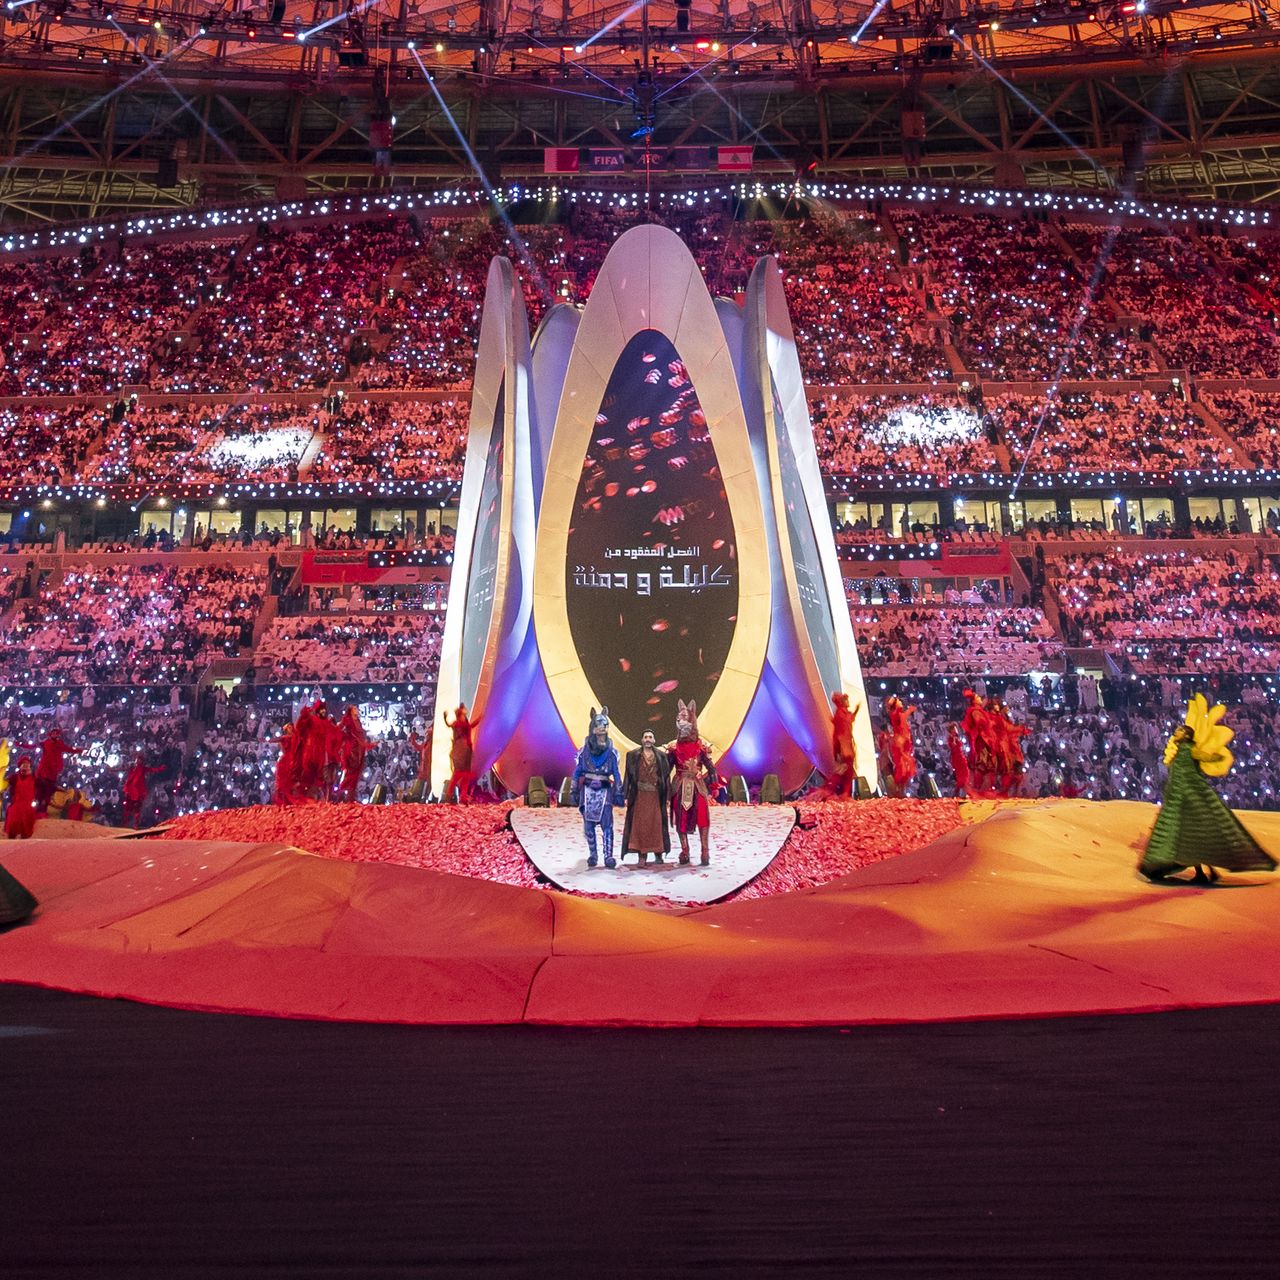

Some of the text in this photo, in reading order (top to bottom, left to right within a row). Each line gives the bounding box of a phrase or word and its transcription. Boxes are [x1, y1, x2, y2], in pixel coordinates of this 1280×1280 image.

[594, 155, 619, 165] FIFA
[604, 546, 700, 560] الفصل المفقود من
[573, 564, 733, 596] كليلة و دمنة
